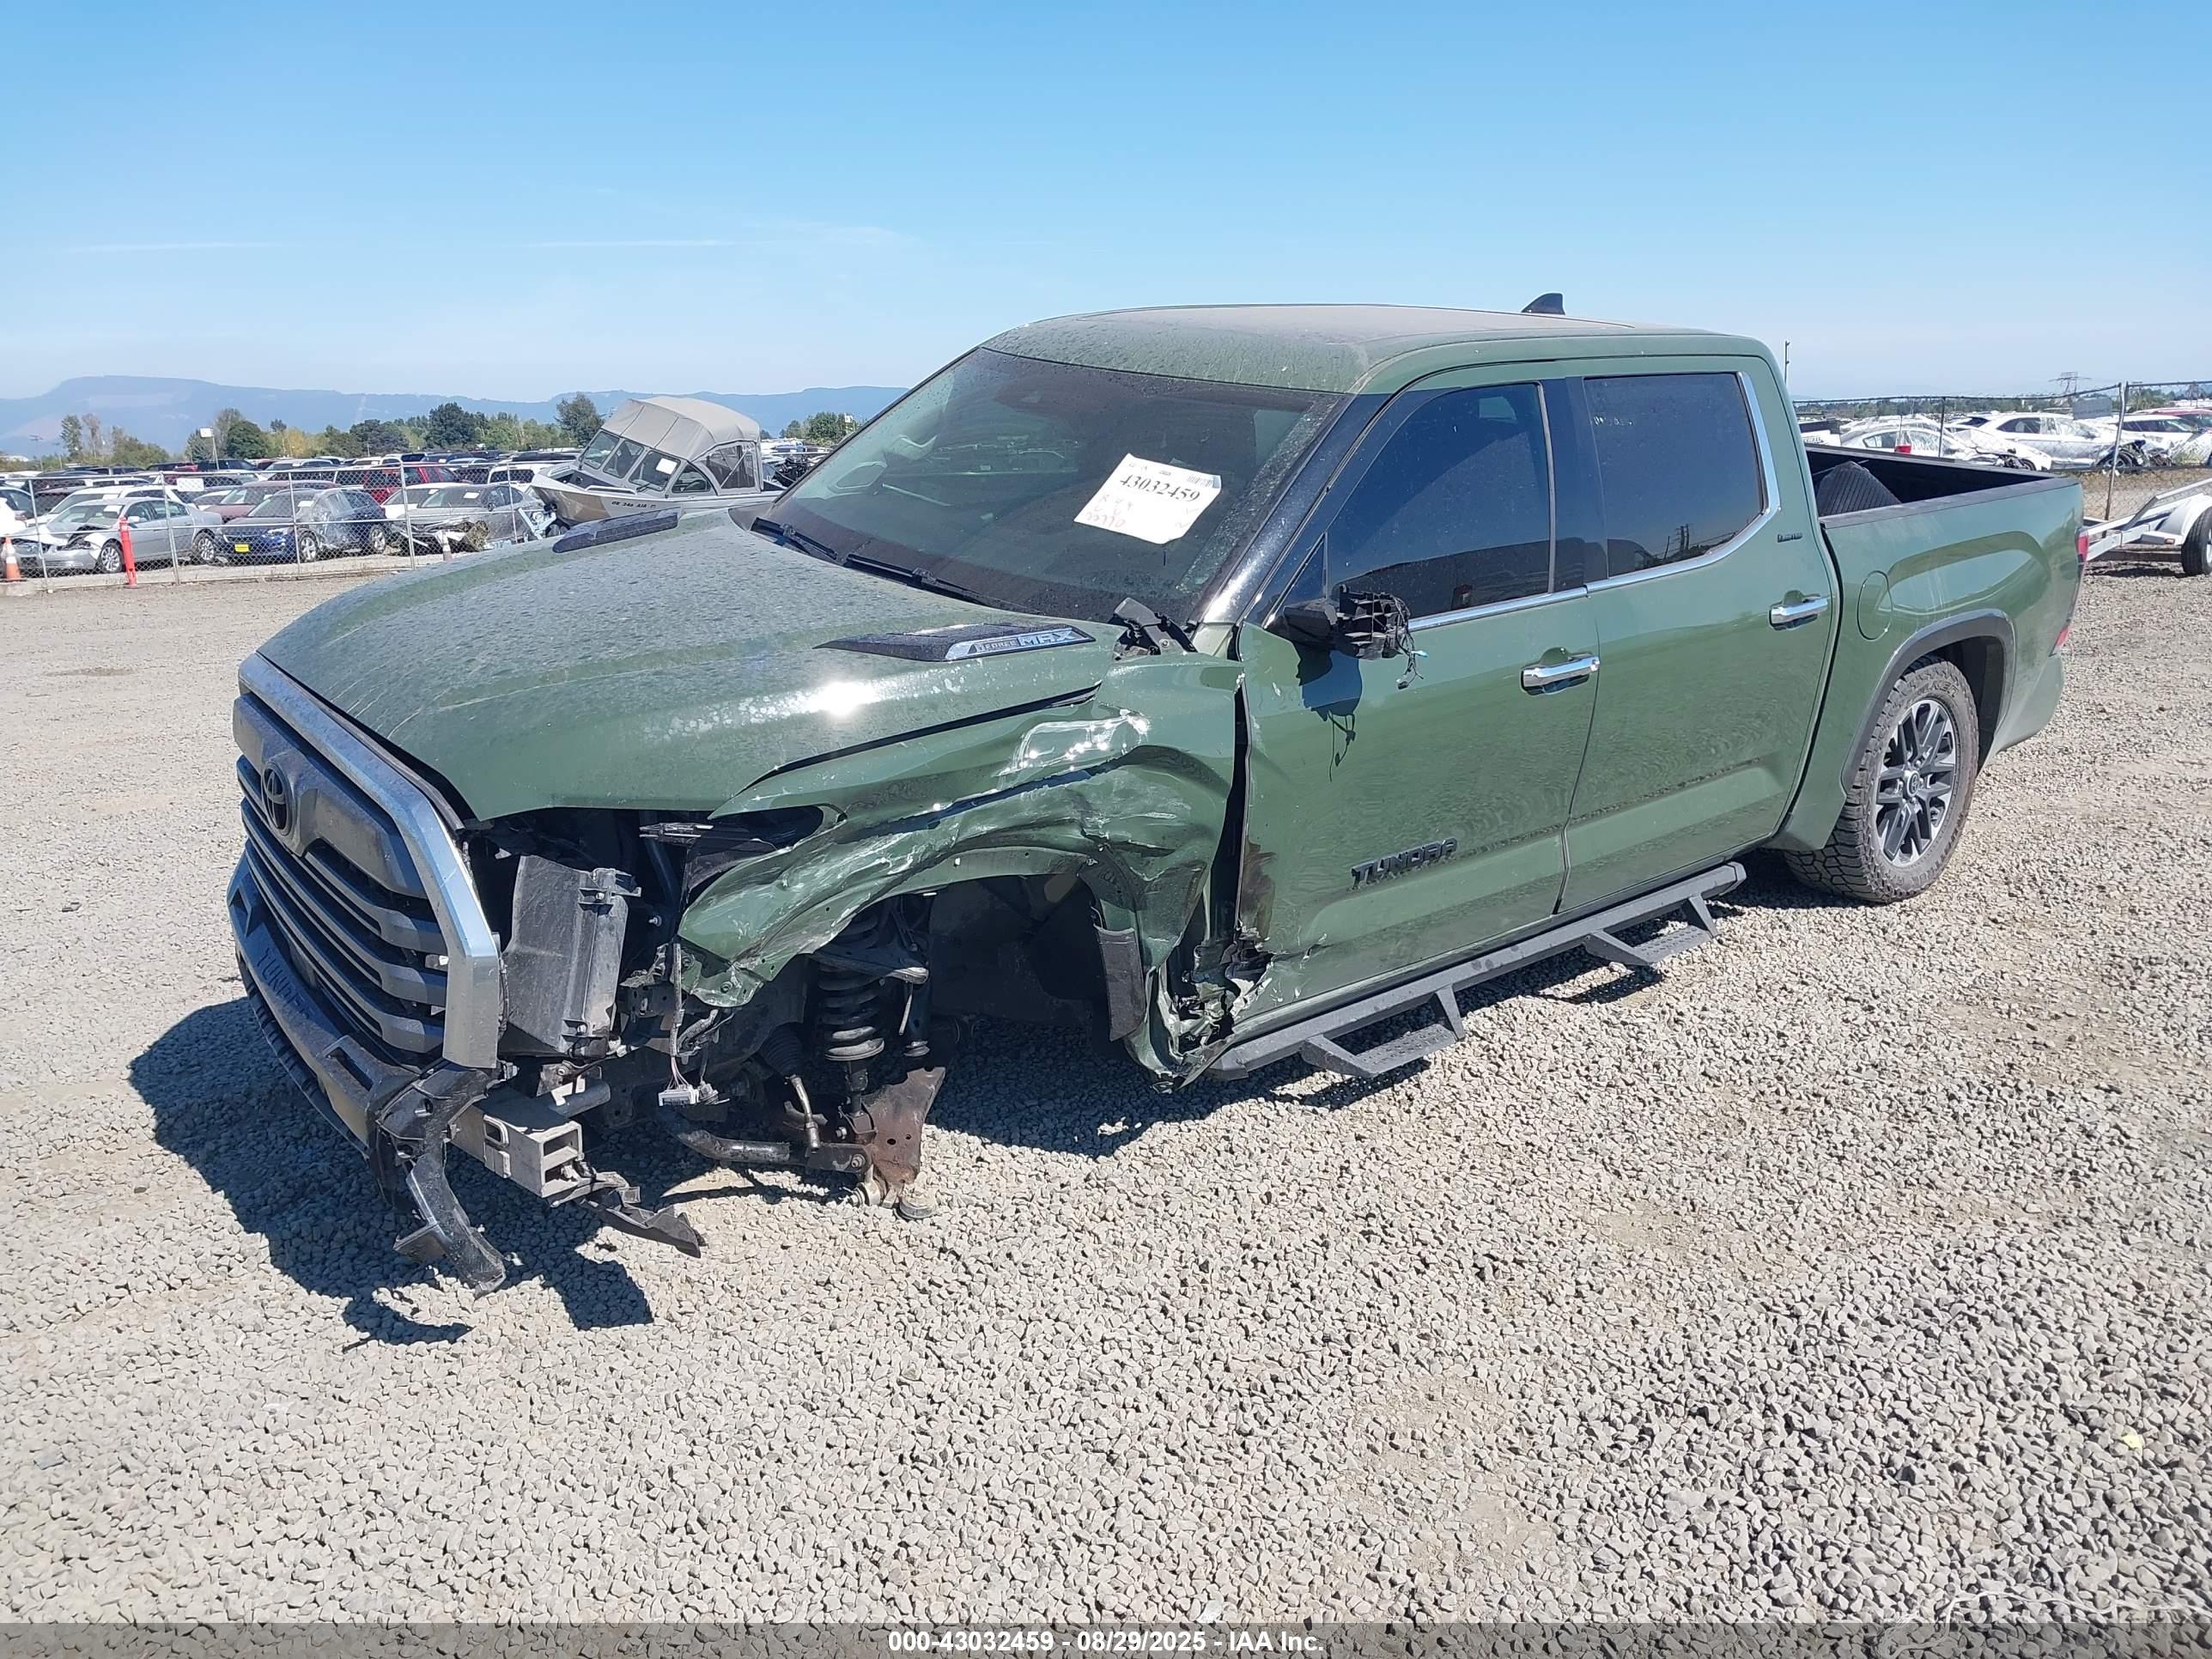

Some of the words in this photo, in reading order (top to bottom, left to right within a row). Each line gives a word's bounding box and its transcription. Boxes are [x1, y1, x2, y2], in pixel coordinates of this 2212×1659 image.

[1119, 474, 1201, 502] 43032459
[1018, 631, 1076, 647] MAX
[1350, 837, 1458, 888] TUNDRA
